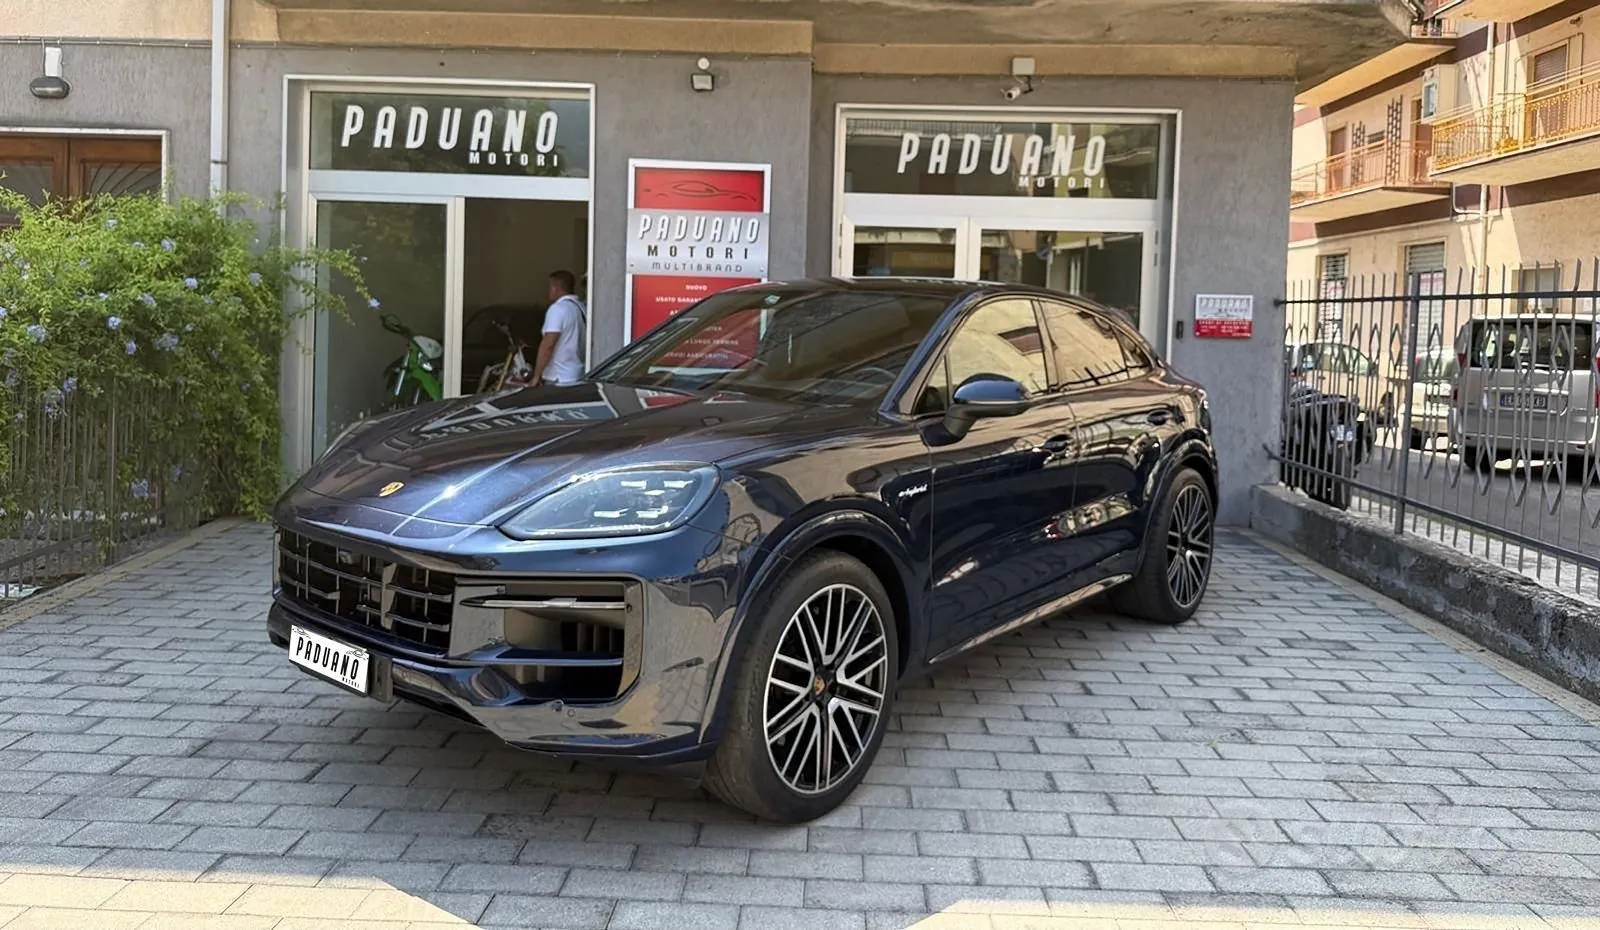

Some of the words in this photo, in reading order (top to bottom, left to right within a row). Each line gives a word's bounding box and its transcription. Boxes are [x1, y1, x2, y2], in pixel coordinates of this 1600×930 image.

[341, 104, 559, 154] PADUANO
[469, 152, 558, 167] MOTORI
[897, 132, 1106, 177] PADUANO
[1018, 176, 1105, 189] MOTORI
[638, 214, 760, 244] PADUANO
[647, 245, 748, 260] MOTORI
[652, 262, 743, 273] MULTIBRAND
[296, 636, 359, 680] PADUANO
